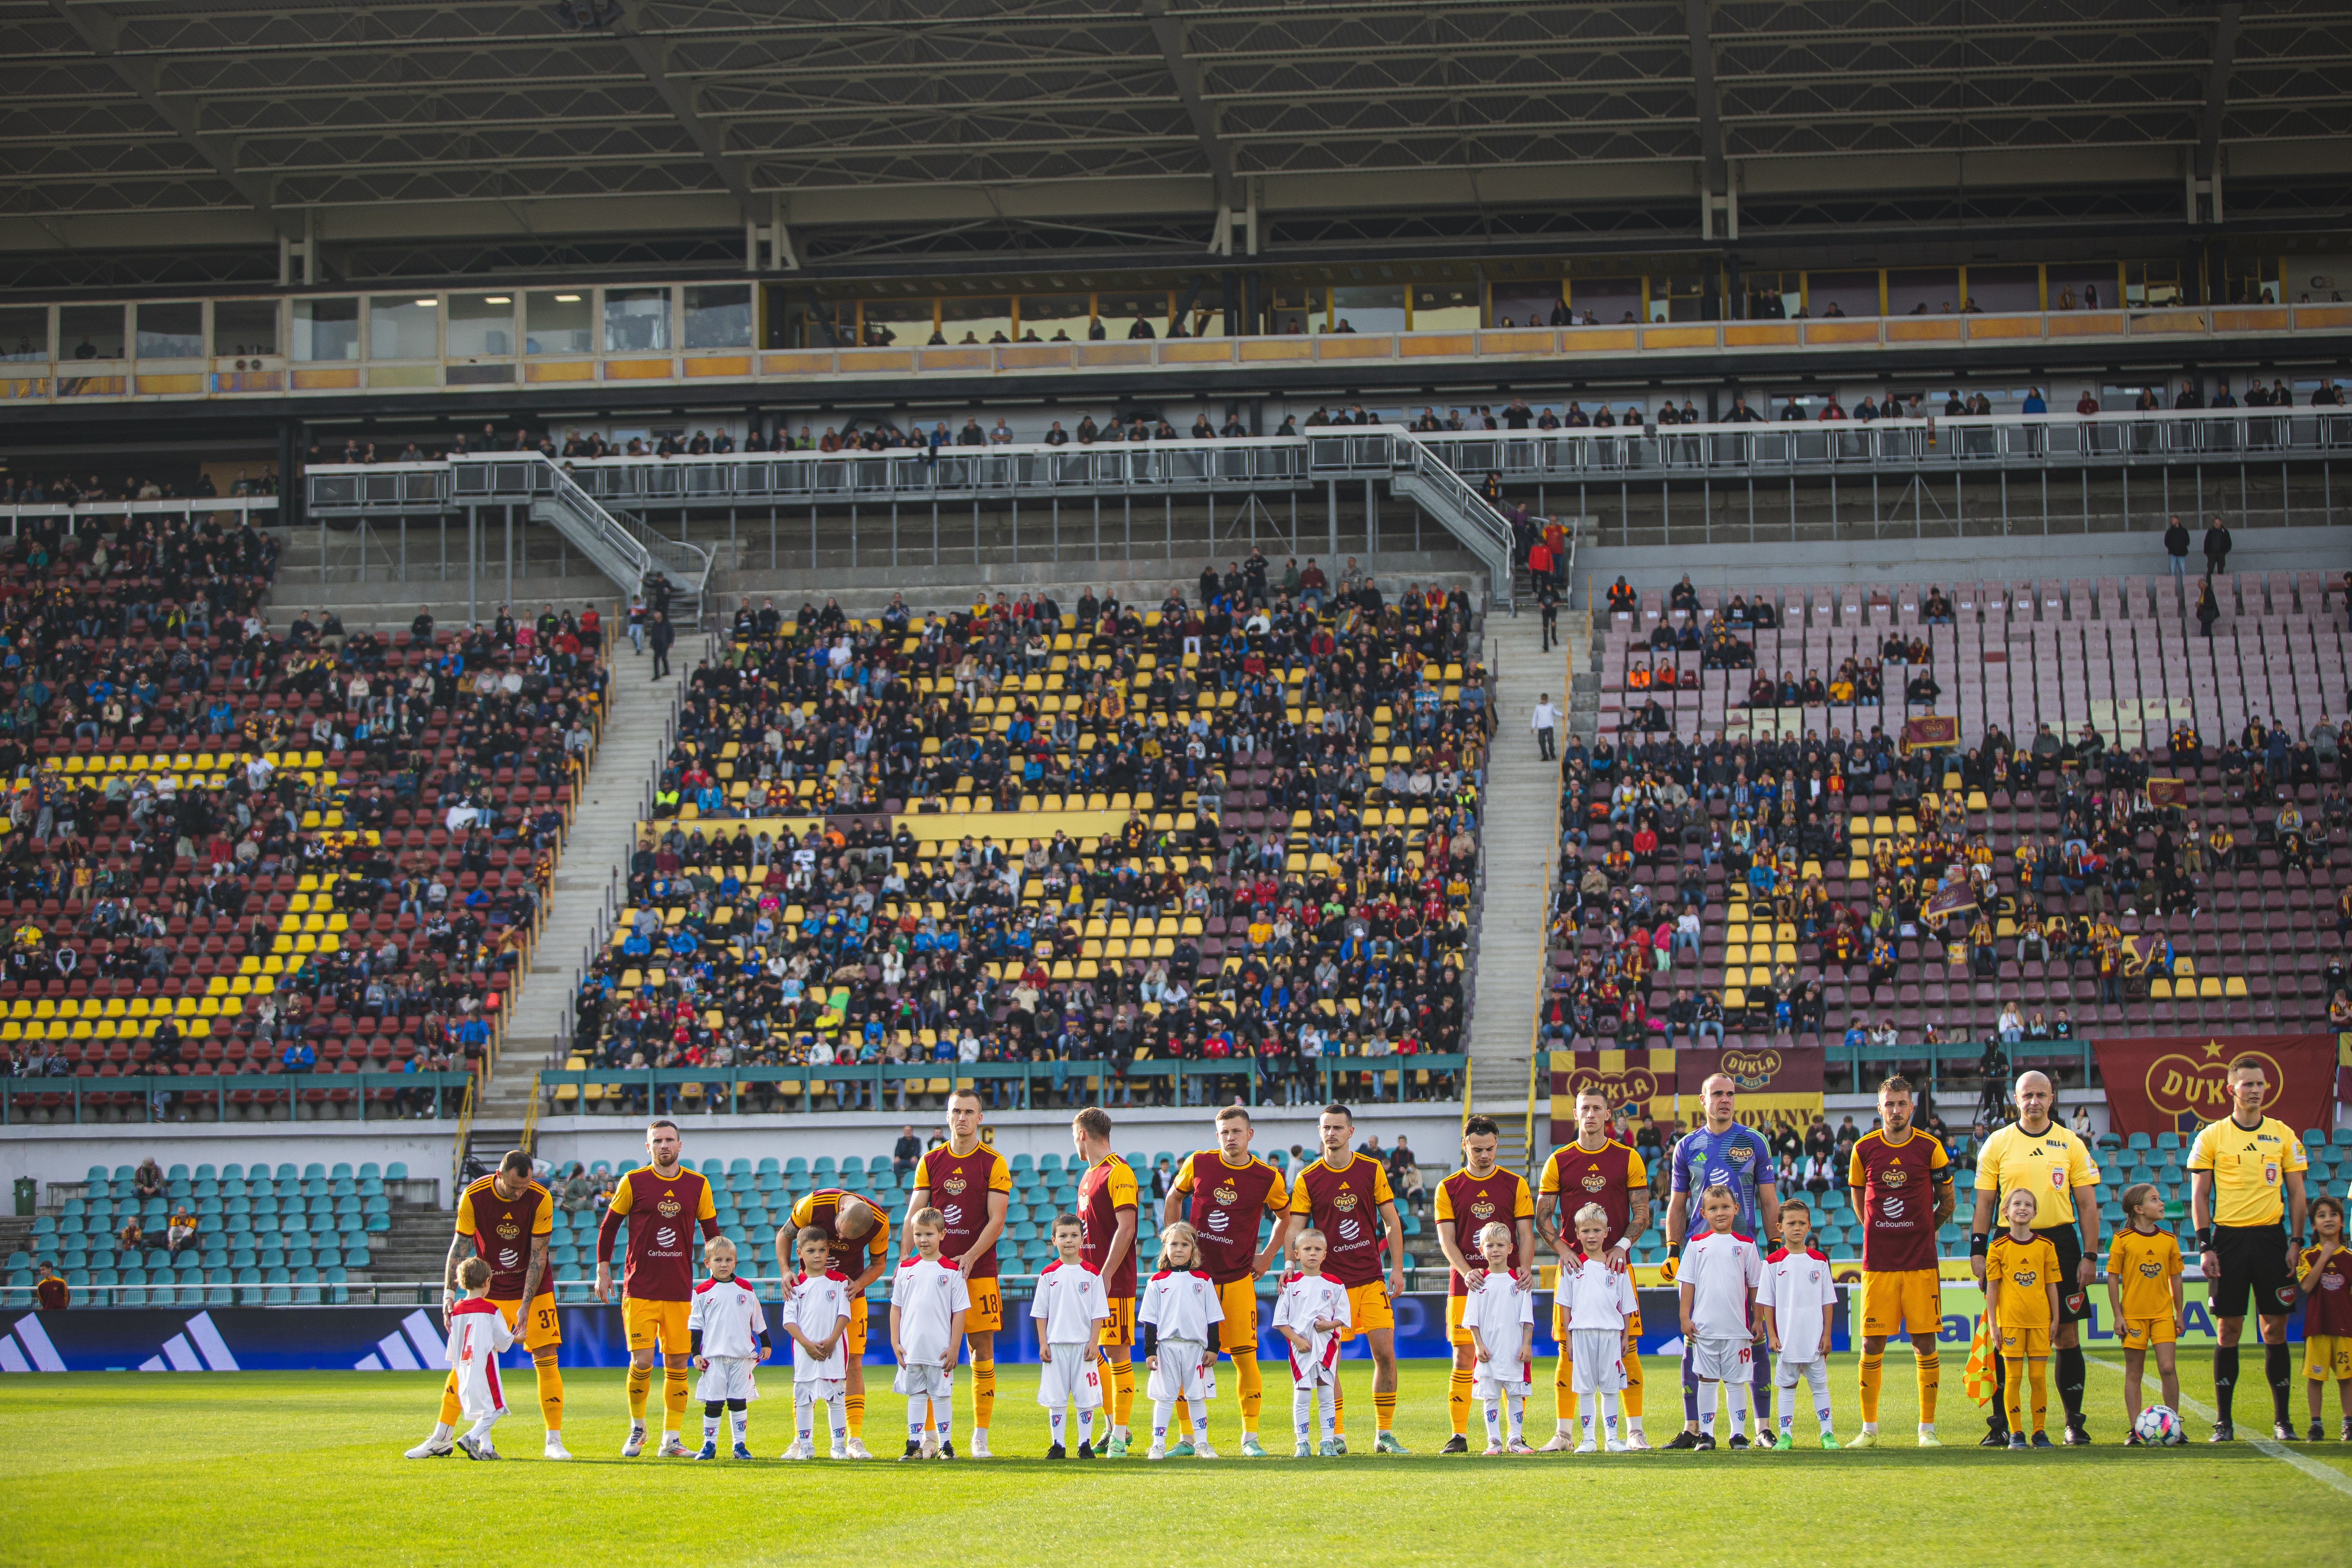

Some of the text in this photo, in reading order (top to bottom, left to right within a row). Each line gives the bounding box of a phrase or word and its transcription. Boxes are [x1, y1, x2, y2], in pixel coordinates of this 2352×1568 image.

[1728, 1056, 1777, 1073] DUKLA
[982, 1127, 993, 1144] C
[1216, 1190, 1235, 1199] DUKLA
[1337, 1197, 1356, 1205] DUKLA
[1196, 1230, 1233, 1245] Carbounion
[1334, 1240, 1370, 1252] Carbounion
[979, 1294, 998, 1315] 18
[1931, 1294, 1938, 1315] 7
[538, 1308, 556, 1329] 37
[1250, 1310, 1256, 1330] 8
[858, 1318, 867, 1338] 1
[1738, 1348, 1751, 1364] 19
[2337, 1351, 2349, 1364] 25
[1086, 1371, 1098, 1387] 18
